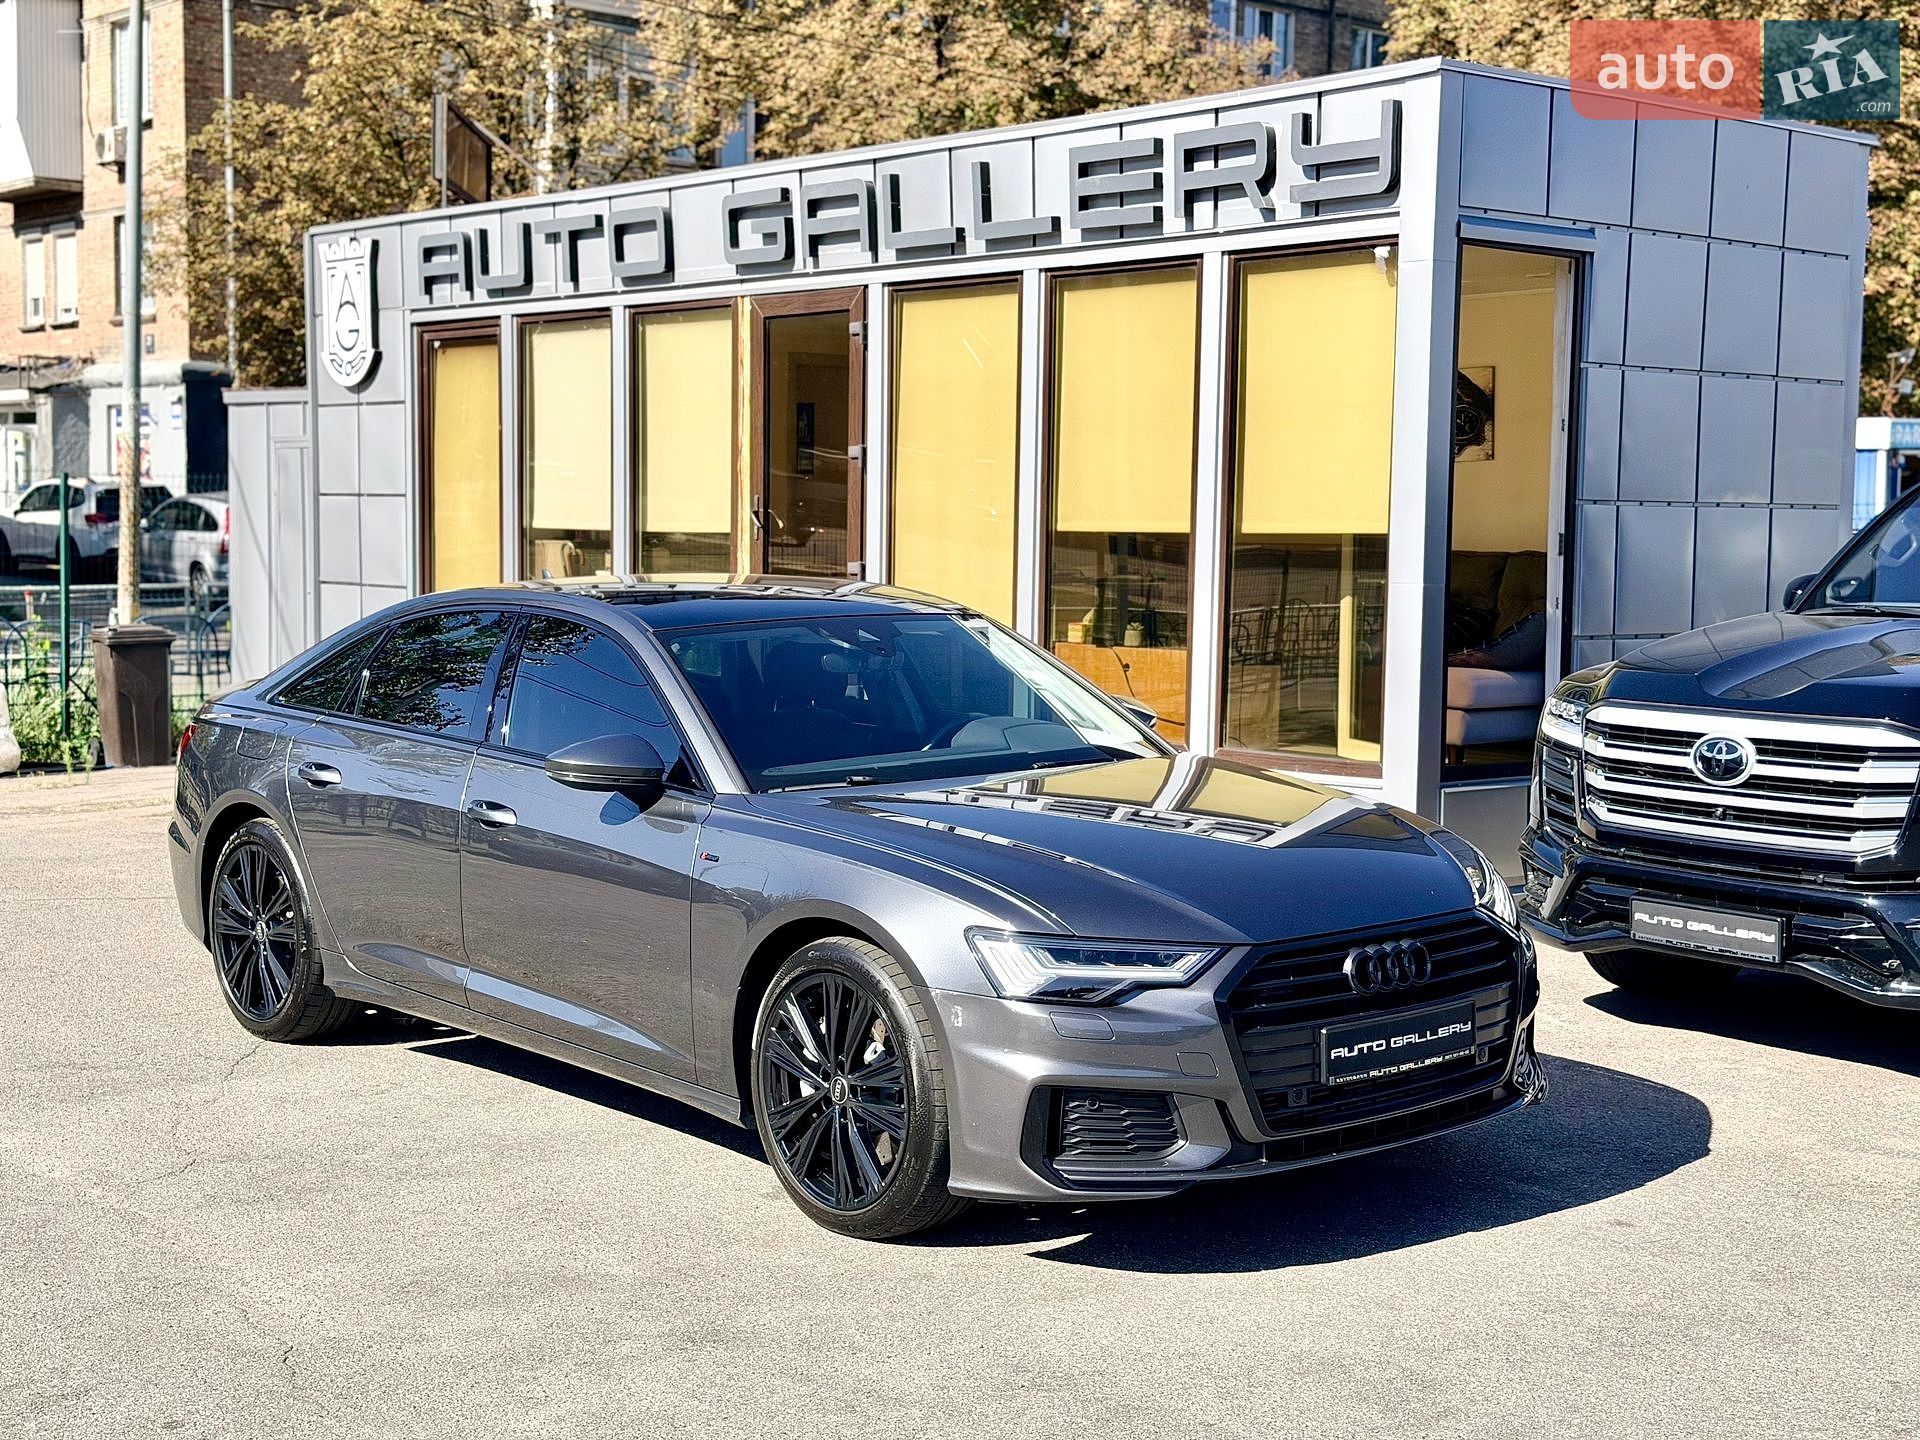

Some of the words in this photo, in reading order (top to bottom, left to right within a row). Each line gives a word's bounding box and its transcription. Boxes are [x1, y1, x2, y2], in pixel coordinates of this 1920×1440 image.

[417, 204, 675, 304] AUTO
[722, 98, 1403, 271] GALLERY
[1634, 912, 1683, 928] AUTO
[1686, 921, 1776, 943] GALLERY
[1330, 1039, 1386, 1060] AUTO
[1390, 1020, 1472, 1048] GALLERY
[1369, 1065, 1398, 1077] AUTO
[1399, 1055, 1443, 1071] GALLERY
